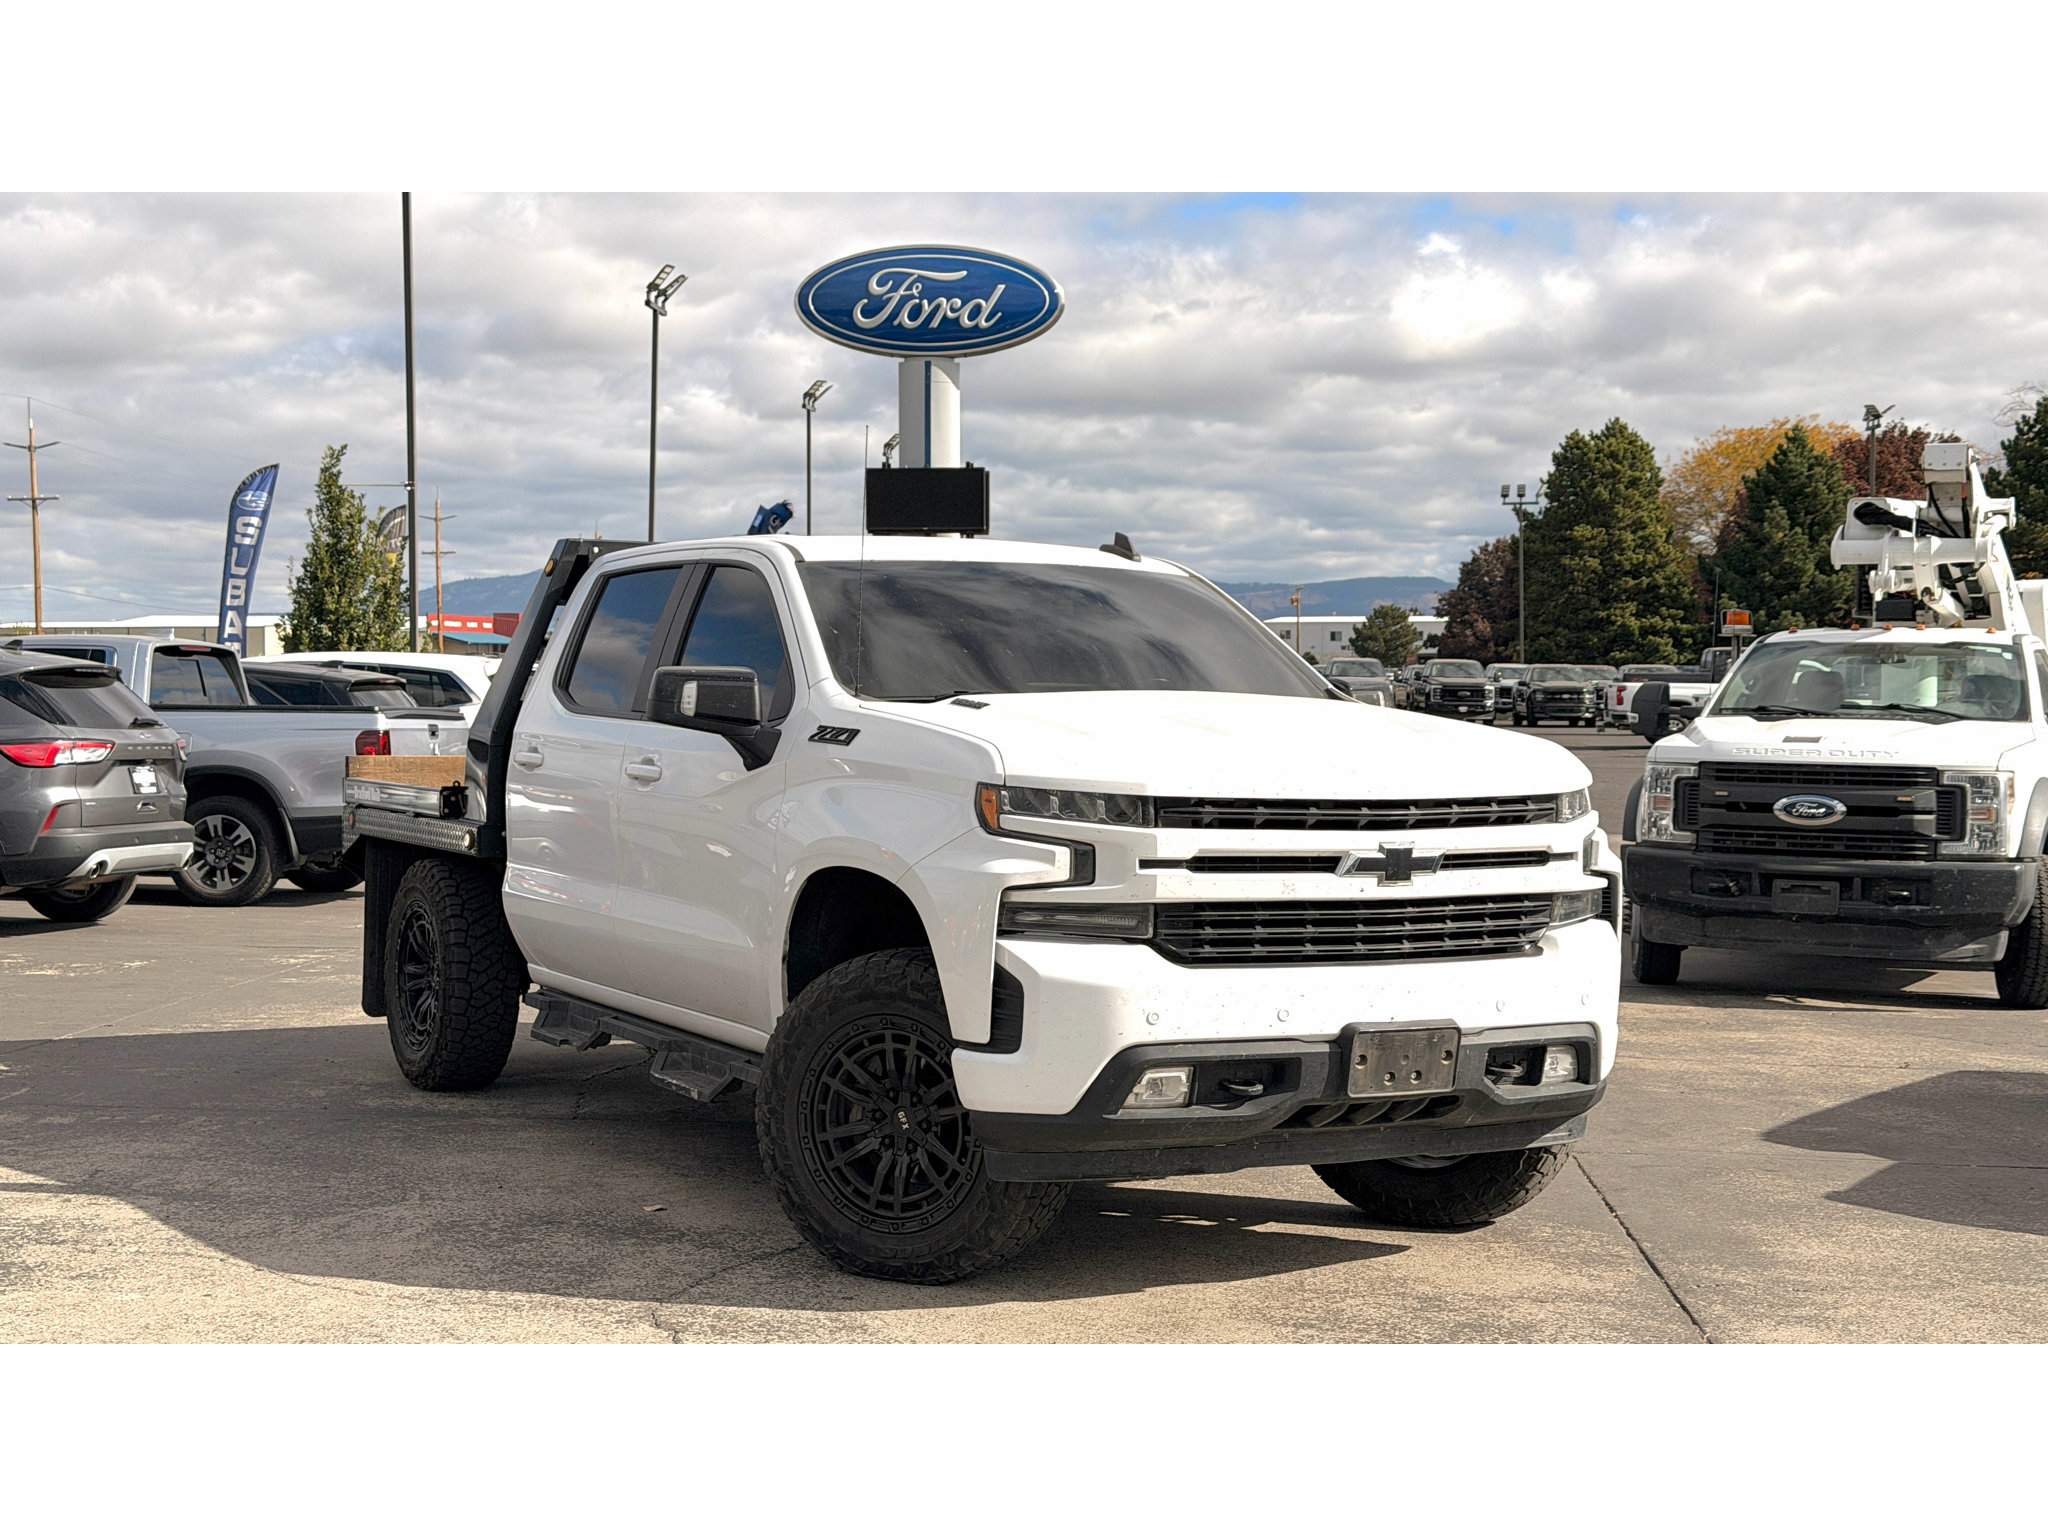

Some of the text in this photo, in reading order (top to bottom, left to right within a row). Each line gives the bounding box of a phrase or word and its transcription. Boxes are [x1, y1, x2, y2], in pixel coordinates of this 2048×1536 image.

[852, 267, 1006, 330] Ford
[808, 725, 861, 746] Z71
[1733, 746, 1899, 758] SUPER DUTY
[1791, 802, 1826, 817] Ford
